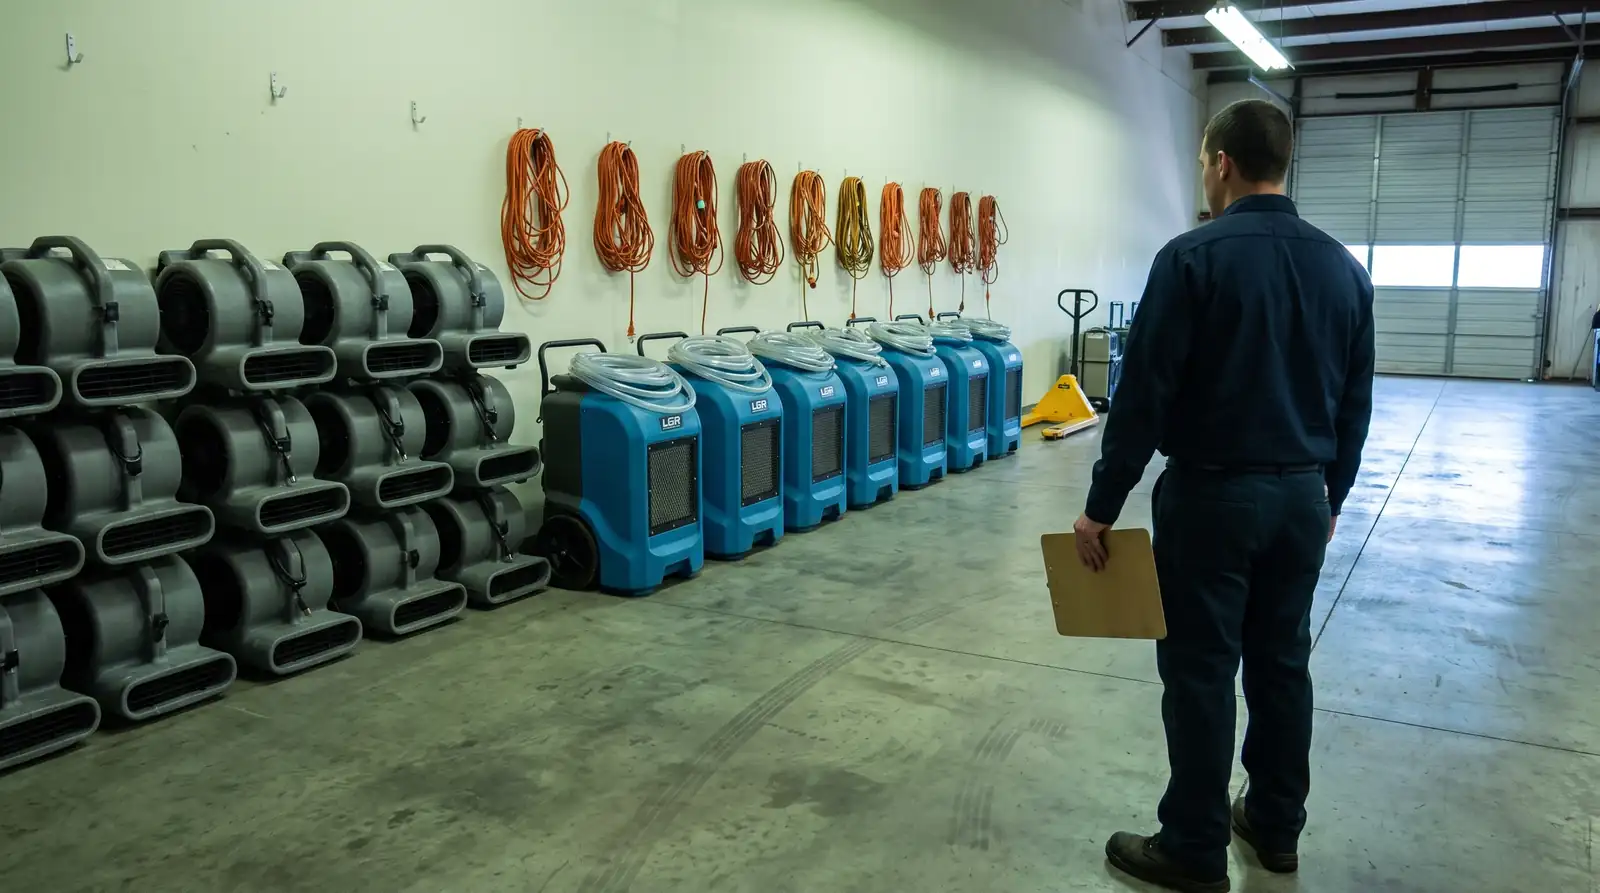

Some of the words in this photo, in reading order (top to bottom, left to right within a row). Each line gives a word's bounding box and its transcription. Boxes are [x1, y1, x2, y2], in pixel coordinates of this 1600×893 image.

[820, 385, 834, 396] LGR
[751, 399, 767, 411] LGR
[662, 415, 681, 428] LGR
